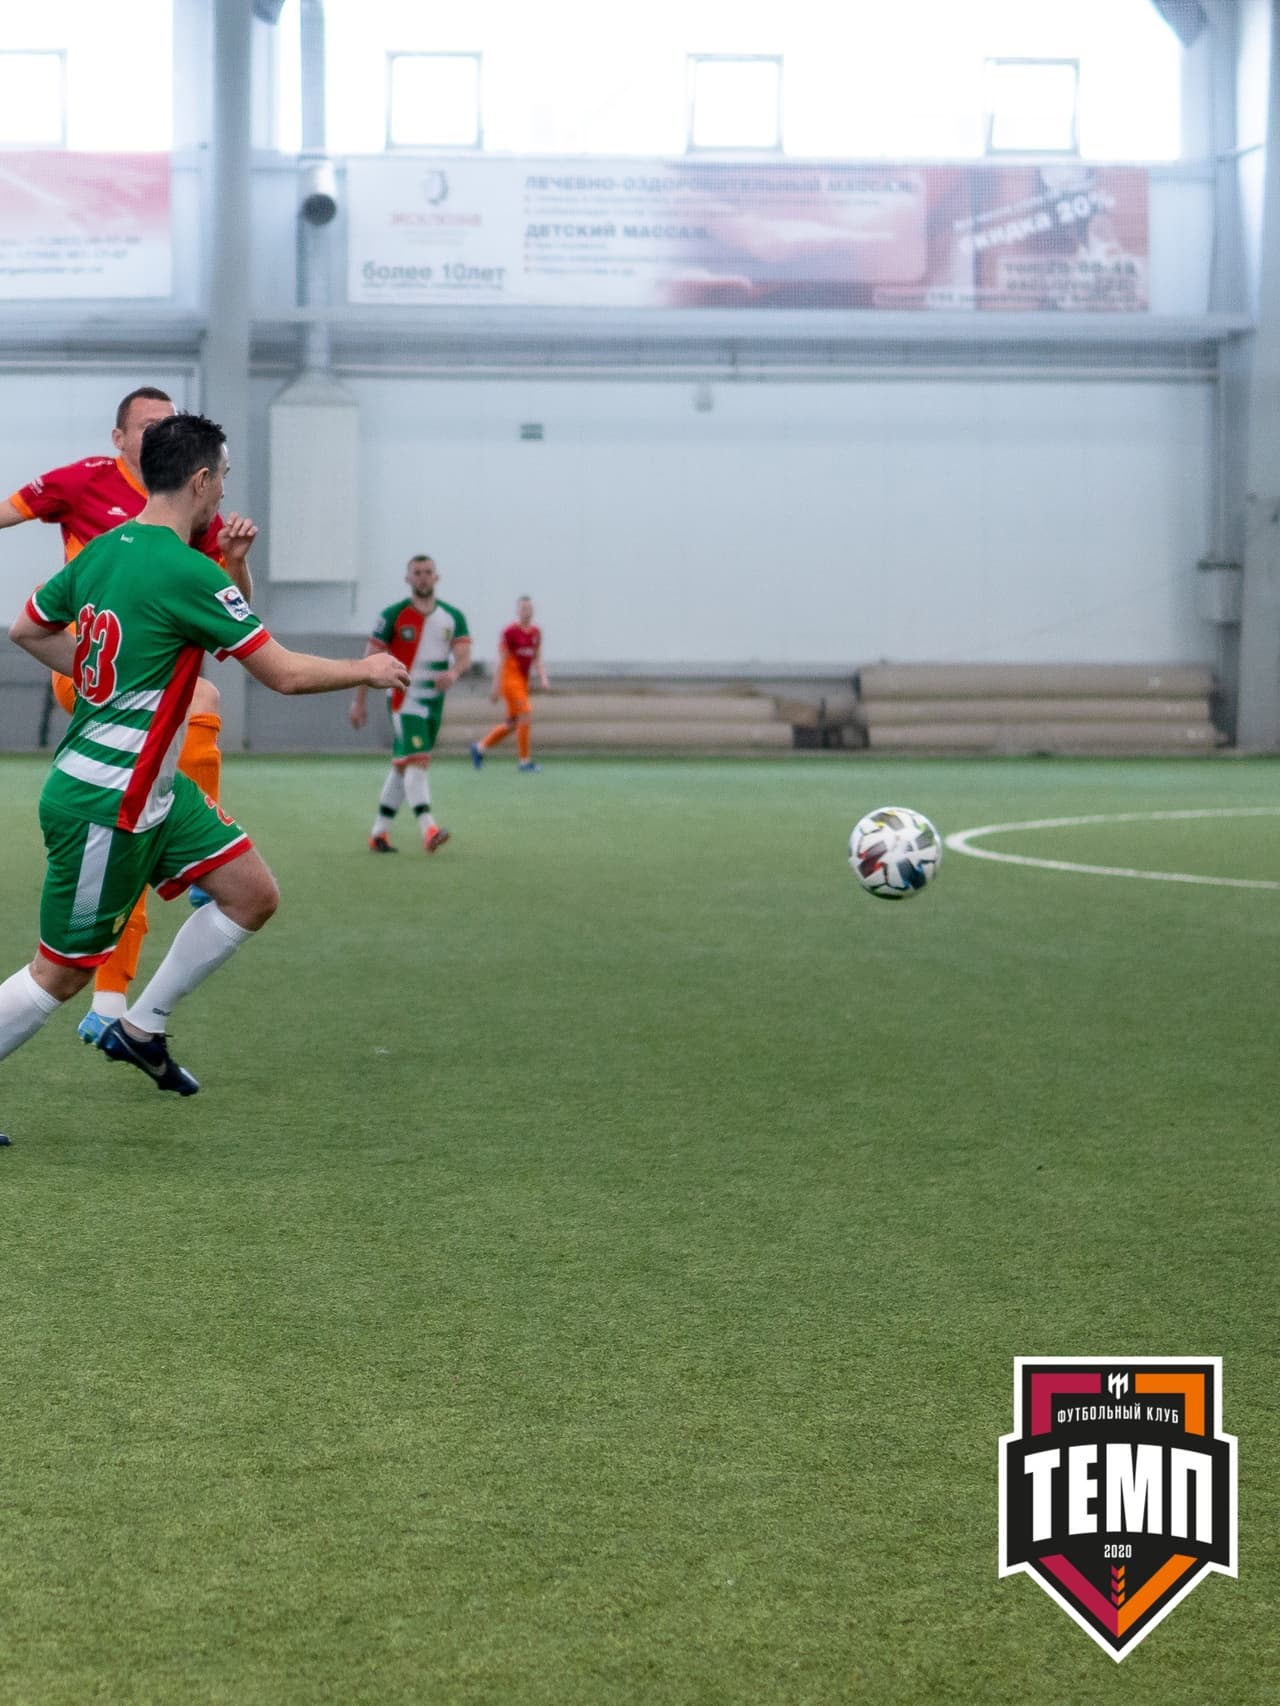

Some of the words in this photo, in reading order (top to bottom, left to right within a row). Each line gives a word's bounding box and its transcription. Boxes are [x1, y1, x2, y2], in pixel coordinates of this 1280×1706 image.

[524, 221, 617, 239] ДЕТСКИЙ
[362, 260, 432, 279] более
[442, 261, 507, 281] 10лет
